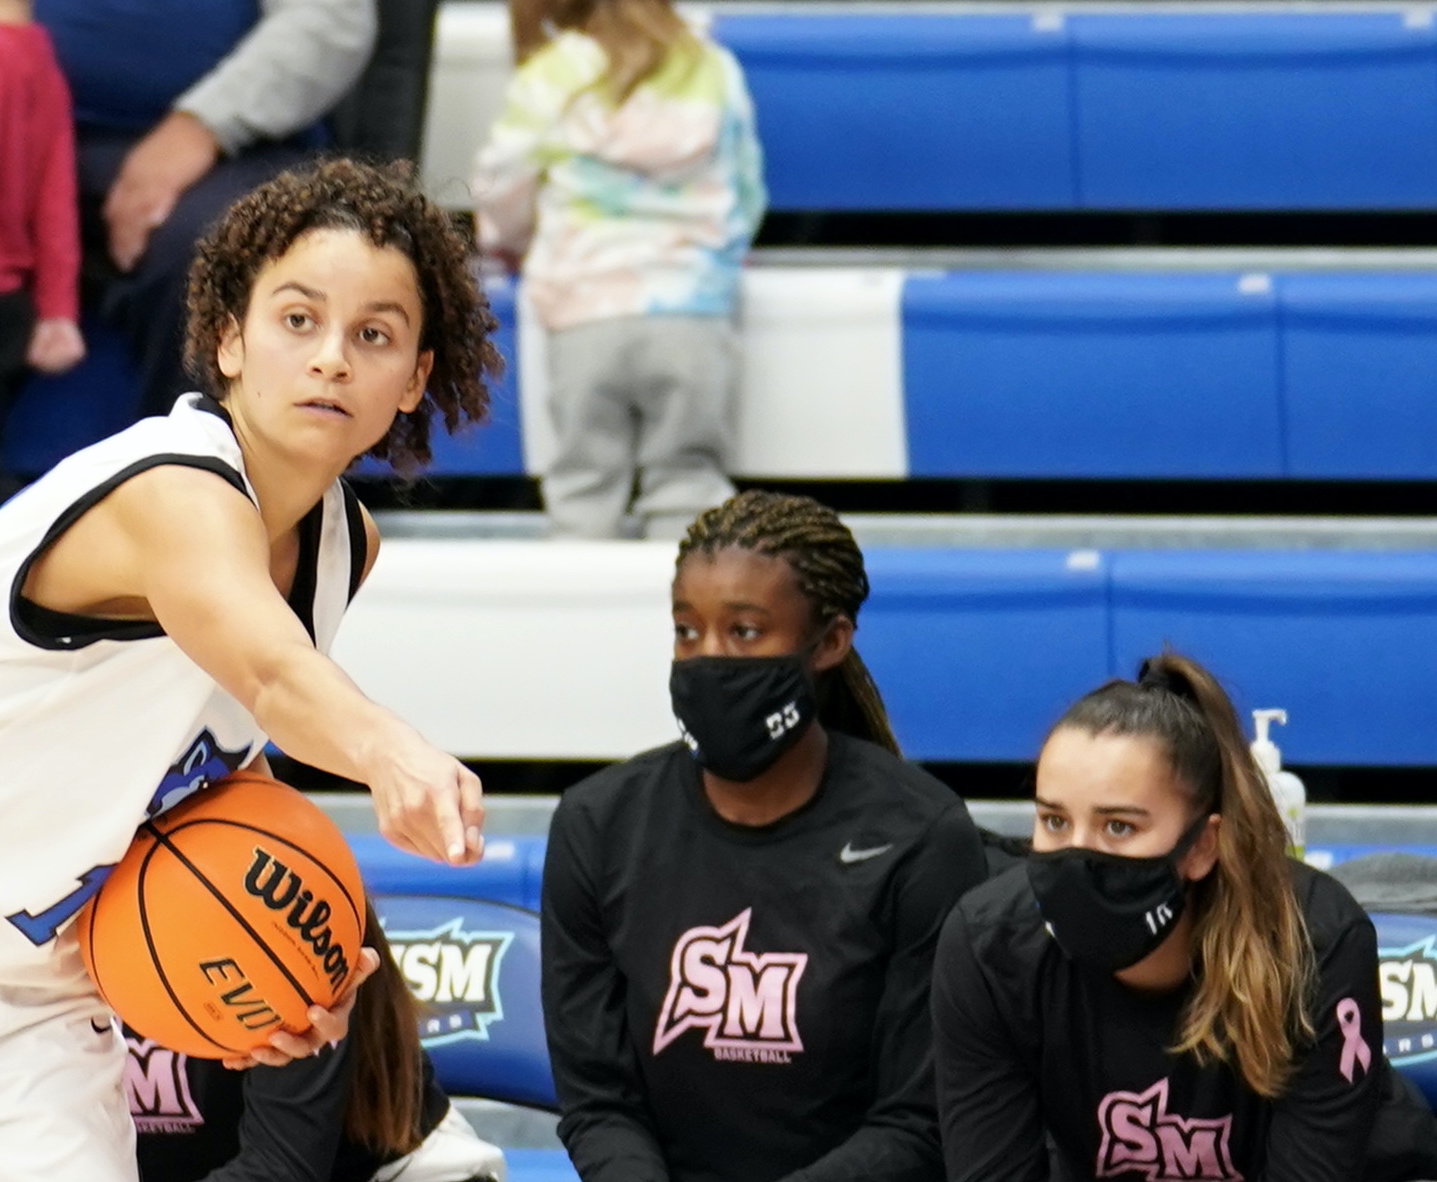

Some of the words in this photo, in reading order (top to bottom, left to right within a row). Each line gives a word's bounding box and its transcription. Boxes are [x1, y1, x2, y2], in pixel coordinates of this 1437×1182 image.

[244, 846, 349, 996] Wilson
[663, 921, 799, 1048] SM
[713, 1048, 792, 1065] BASKETBALL
[1104, 1090, 1234, 1182] SM
